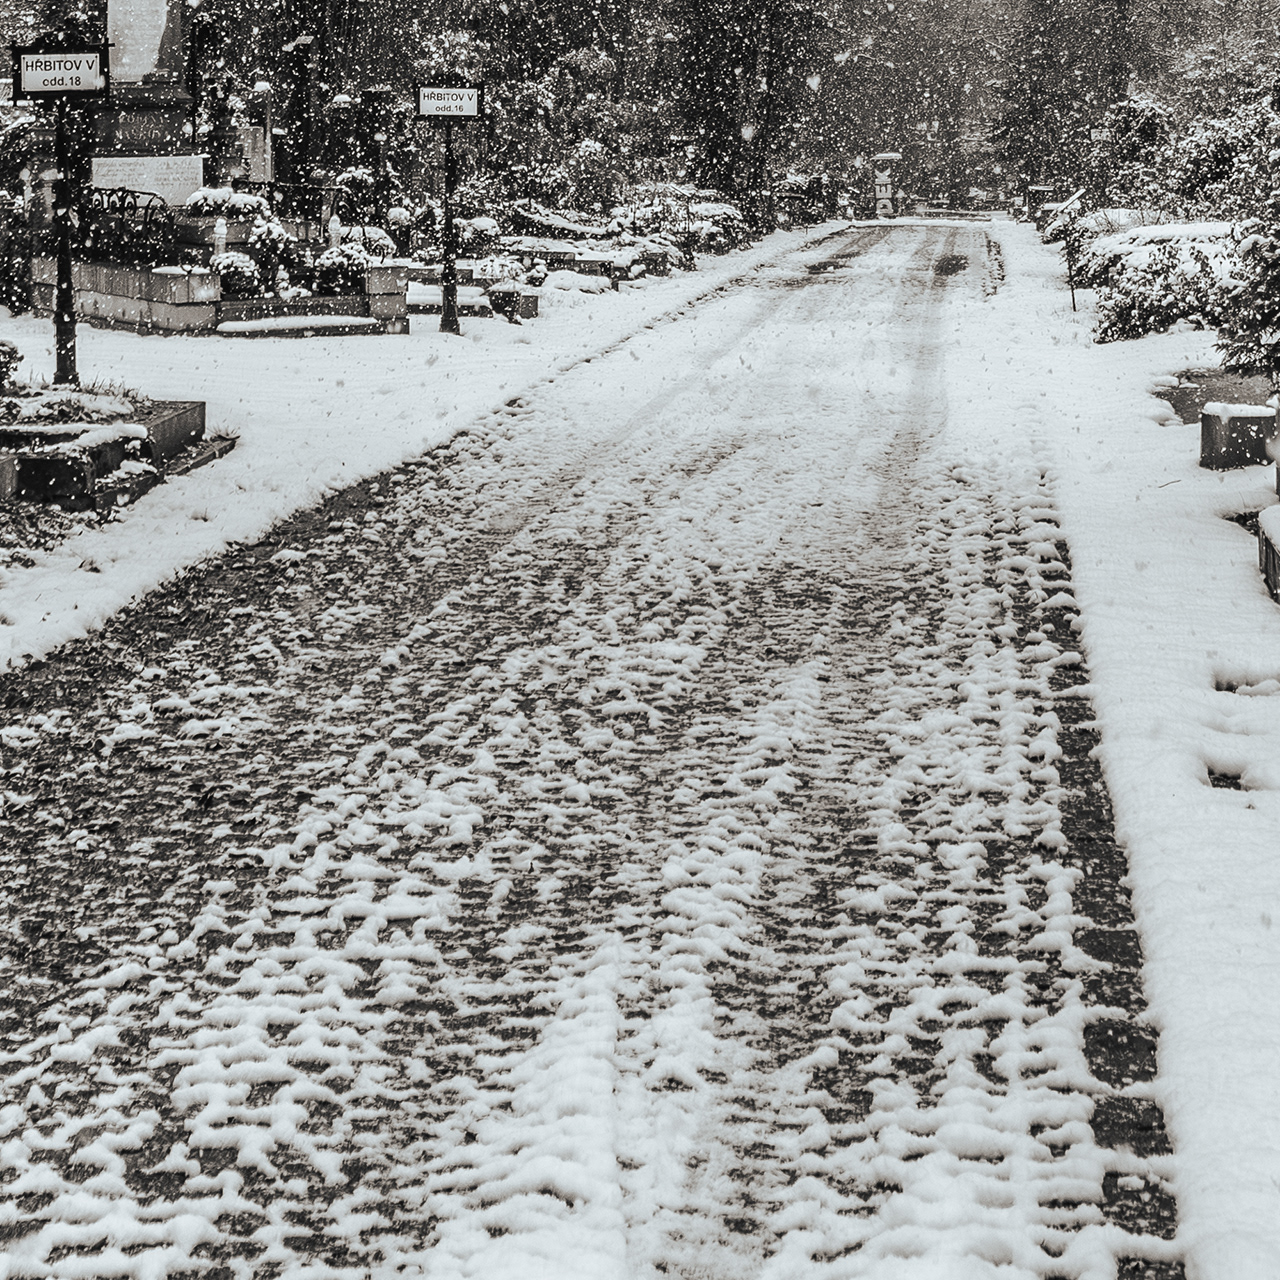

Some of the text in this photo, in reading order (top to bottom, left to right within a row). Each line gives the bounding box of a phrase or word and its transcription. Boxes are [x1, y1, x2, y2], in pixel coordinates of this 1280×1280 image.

[25, 59, 95, 71] HŘBITOV V
[43, 76, 81, 86] odd.18
[423, 91, 474, 101] HŘBITOV V
